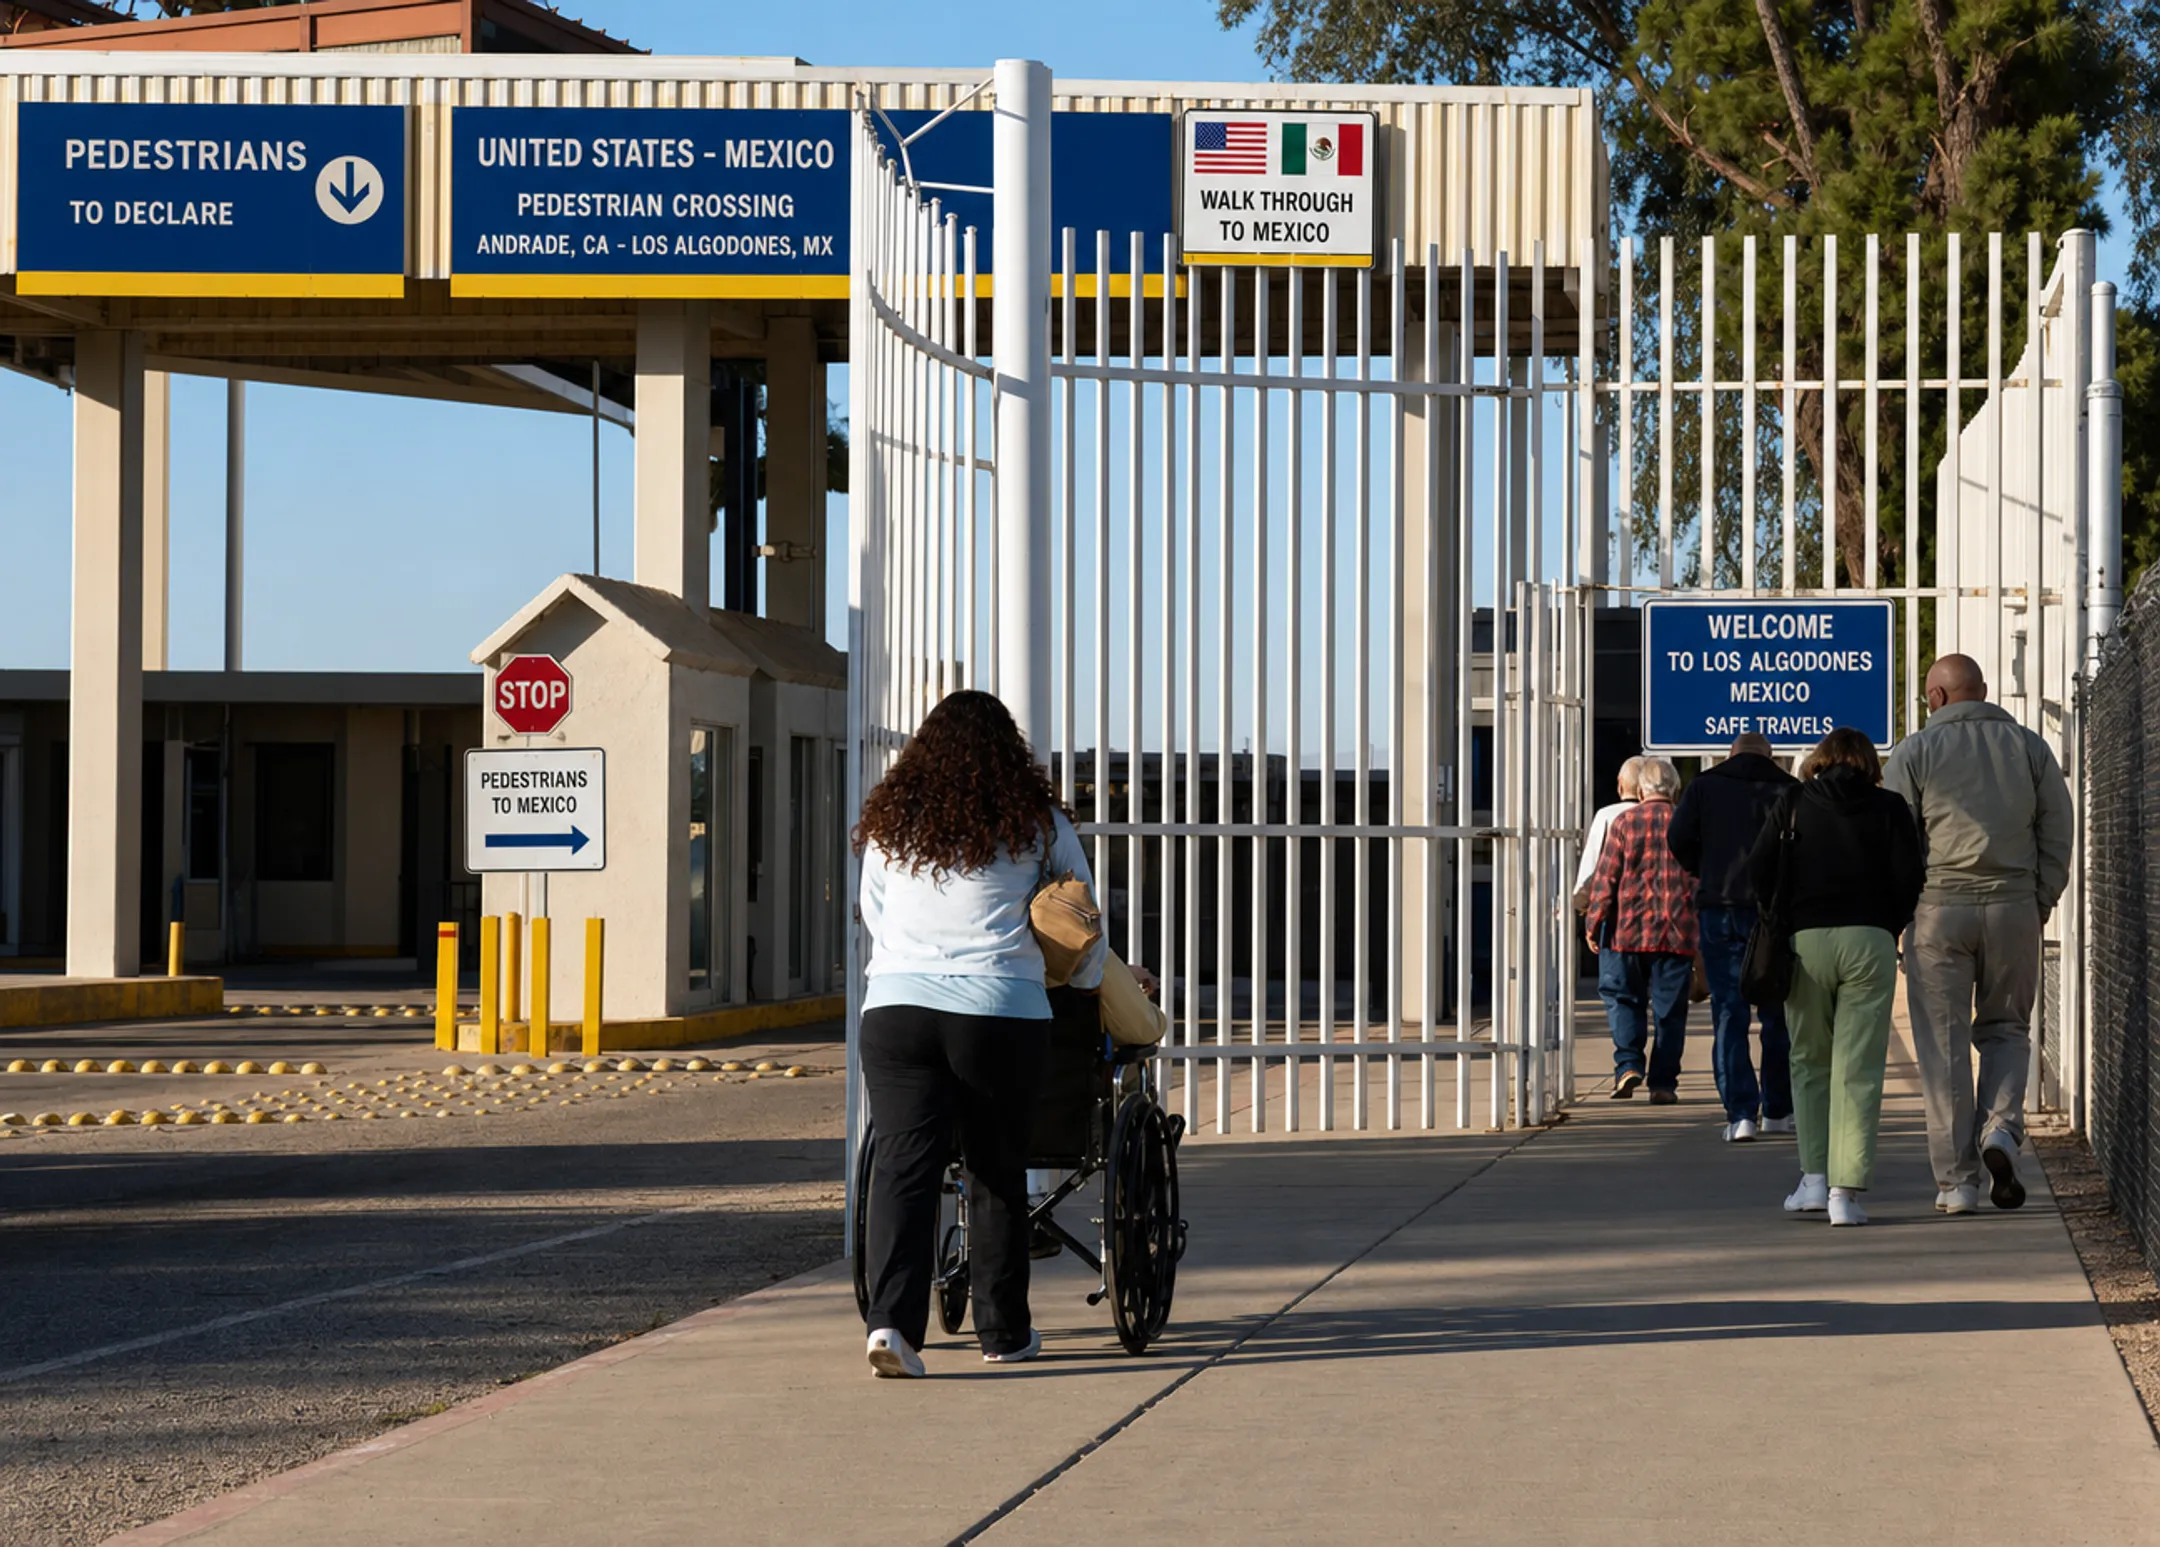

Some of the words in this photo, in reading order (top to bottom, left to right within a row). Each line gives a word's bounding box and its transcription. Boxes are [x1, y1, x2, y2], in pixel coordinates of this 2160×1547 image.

[65, 139, 307, 172] PEDESTRIANS
[478, 137, 583, 168] UNITED
[591, 138, 695, 168] STATES
[725, 139, 834, 169] MEXICO
[69, 200, 104, 225] TO
[114, 201, 234, 226] DECLARE
[518, 192, 663, 217] PEDESTRIAN
[672, 193, 794, 218] CROSSING
[1200, 189, 1255, 211] WALK
[1259, 190, 1354, 213] THROUGH
[1219, 219, 1245, 242] TO
[1253, 221, 1330, 243] MEXICO
[476, 234, 576, 258] ANDRADE,
[583, 234, 610, 255] CA
[632, 235, 669, 255] LOS
[674, 235, 797, 260] ALGODONES,
[803, 235, 833, 256] MX
[1707, 613, 1834, 640] WELCOME
[1667, 651, 1694, 672] TO
[1703, 650, 1742, 672] LOS
[1749, 650, 1873, 672] ALGODONES
[499, 680, 567, 710] STOP
[1730, 681, 1810, 703] MEXICO
[1705, 716, 1750, 735] SAFE
[1755, 716, 1834, 735] TRAVELS
[481, 770, 588, 790] PEDESTRIANS
[491, 796, 512, 815] TO
[517, 795, 577, 815] MEXICO
